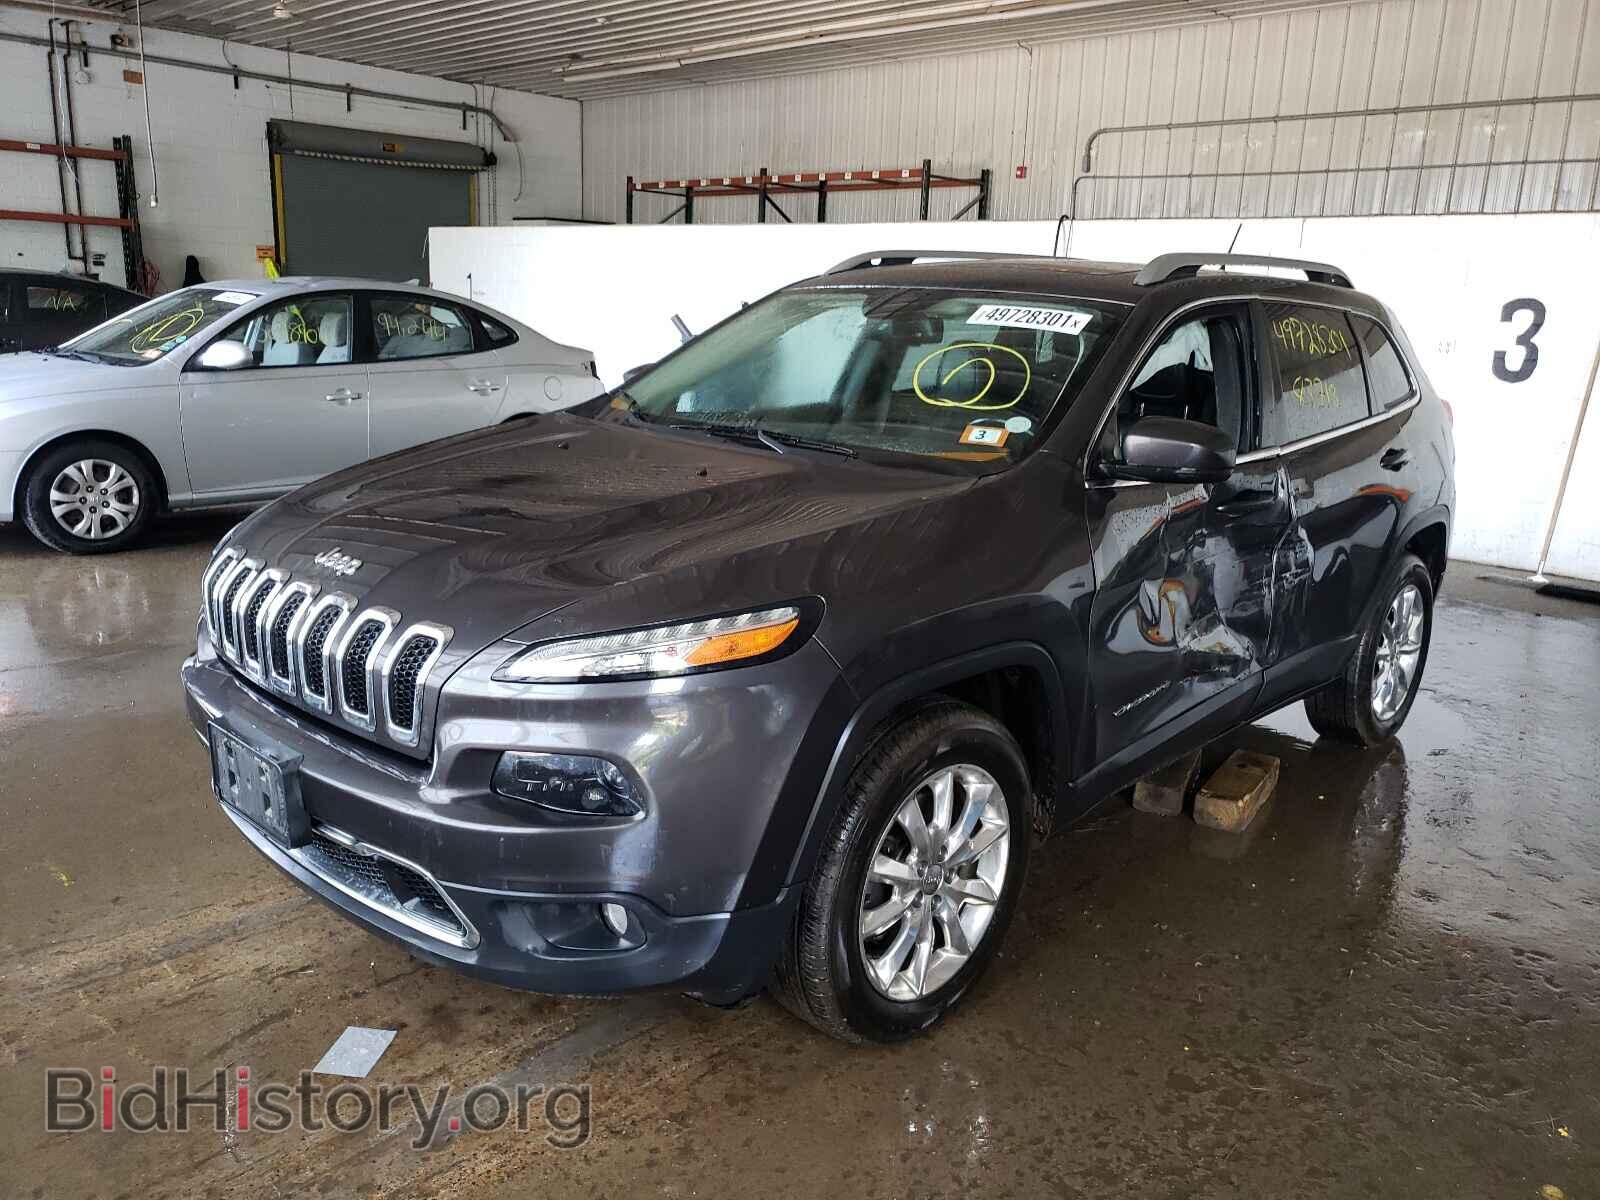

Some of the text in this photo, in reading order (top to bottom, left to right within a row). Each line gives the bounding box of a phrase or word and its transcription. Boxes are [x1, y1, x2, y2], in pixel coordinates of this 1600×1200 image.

[985, 307, 1073, 328] 49728301
[1492, 297, 1546, 383] 3
[975, 429, 987, 440] 3
[314, 546, 362, 577] Jeep
